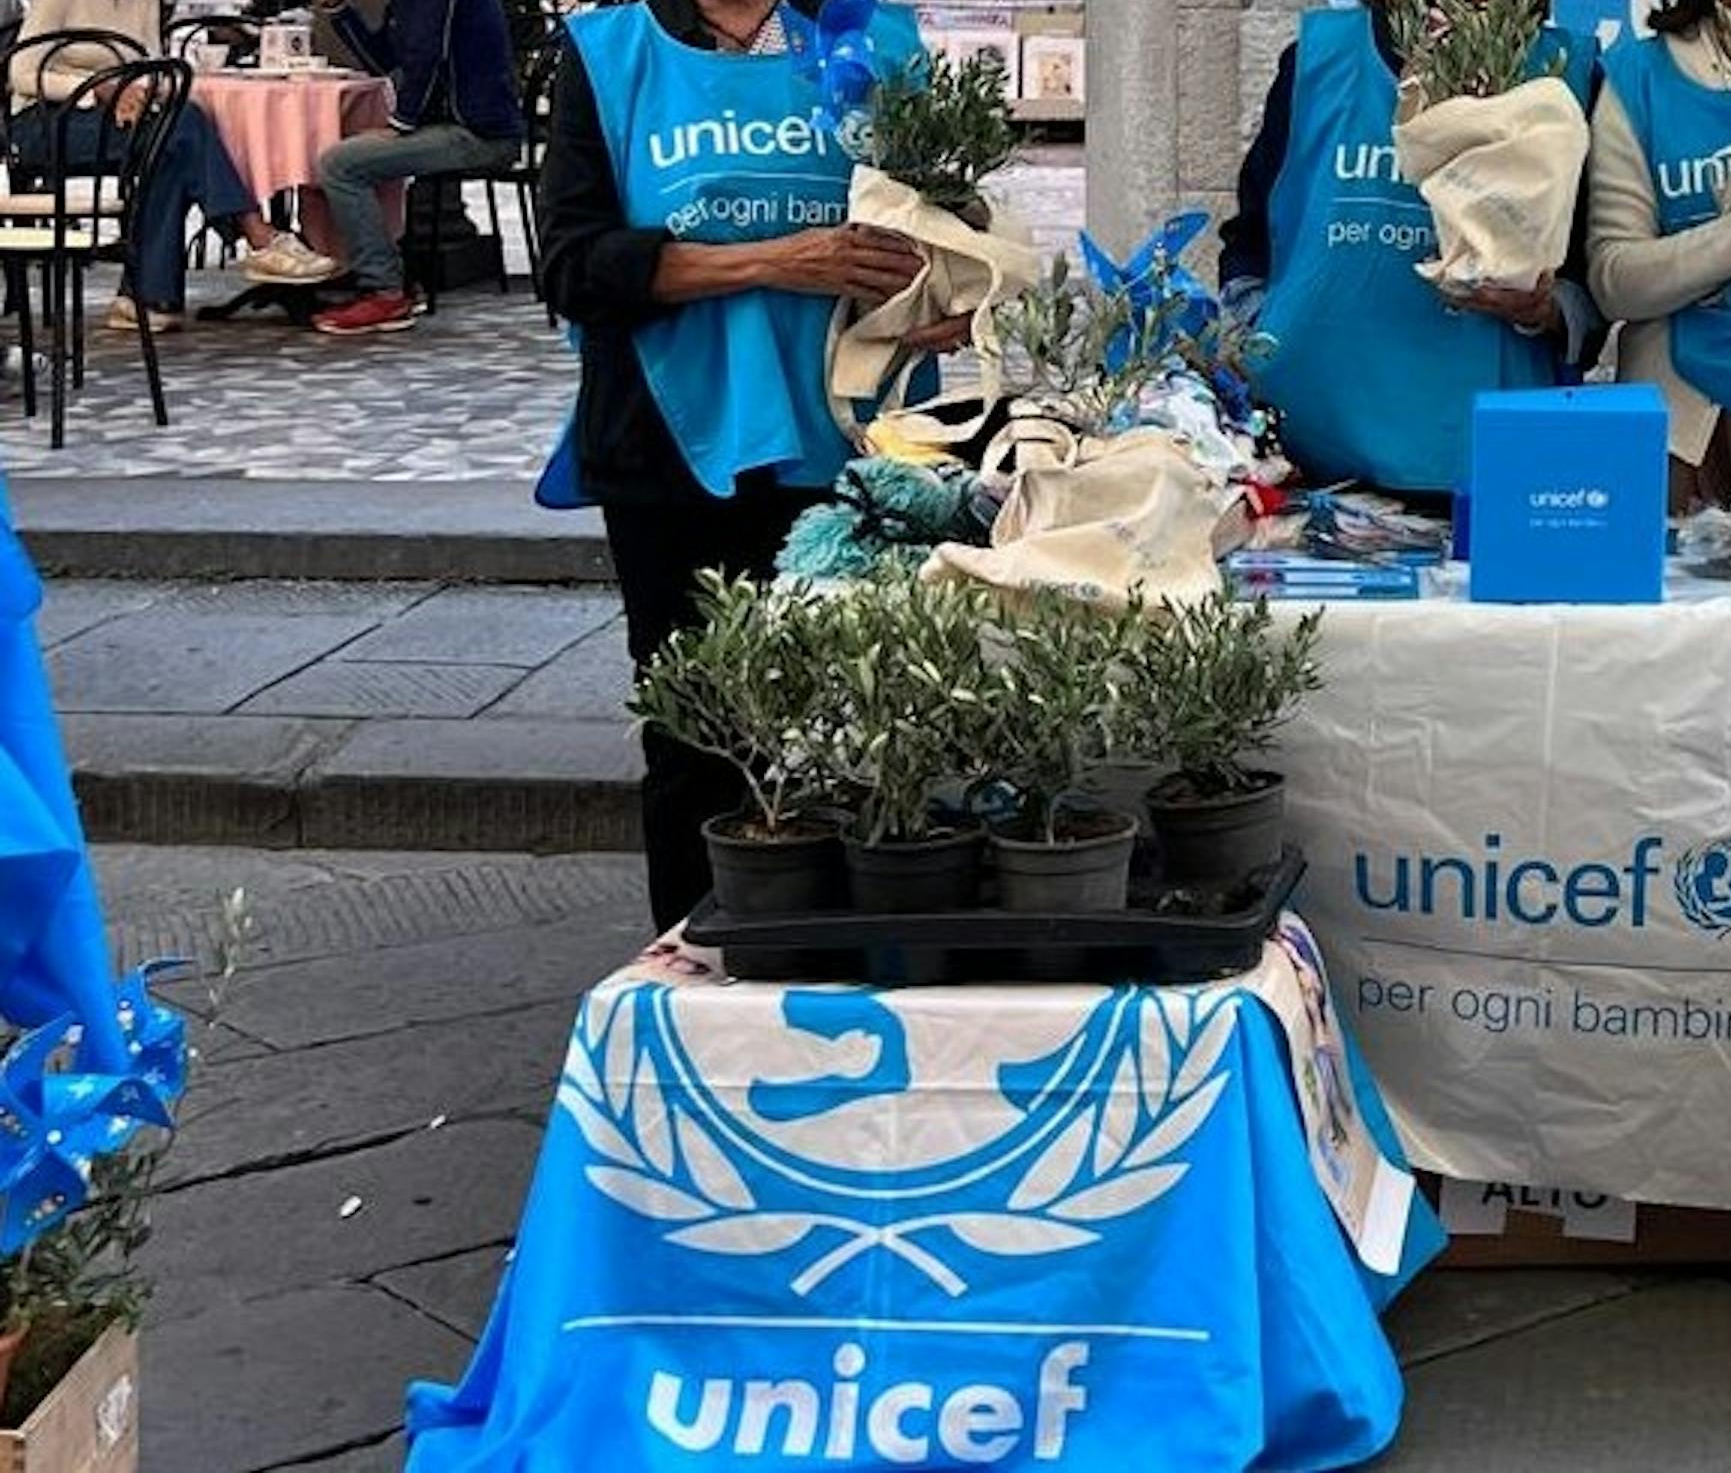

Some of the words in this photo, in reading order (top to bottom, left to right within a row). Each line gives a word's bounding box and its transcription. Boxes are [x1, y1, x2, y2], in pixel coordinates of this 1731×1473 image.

[712, 191, 779, 227] ogni
[1327, 220, 1371, 249] per
[1378, 220, 1431, 251] ogn
[1528, 487, 1585, 508] unicef
[1354, 833, 1663, 928] unicef
[1357, 973, 1434, 1014] per
[1451, 987, 1553, 1034] ogni
[646, 1341, 1090, 1464] unicef
